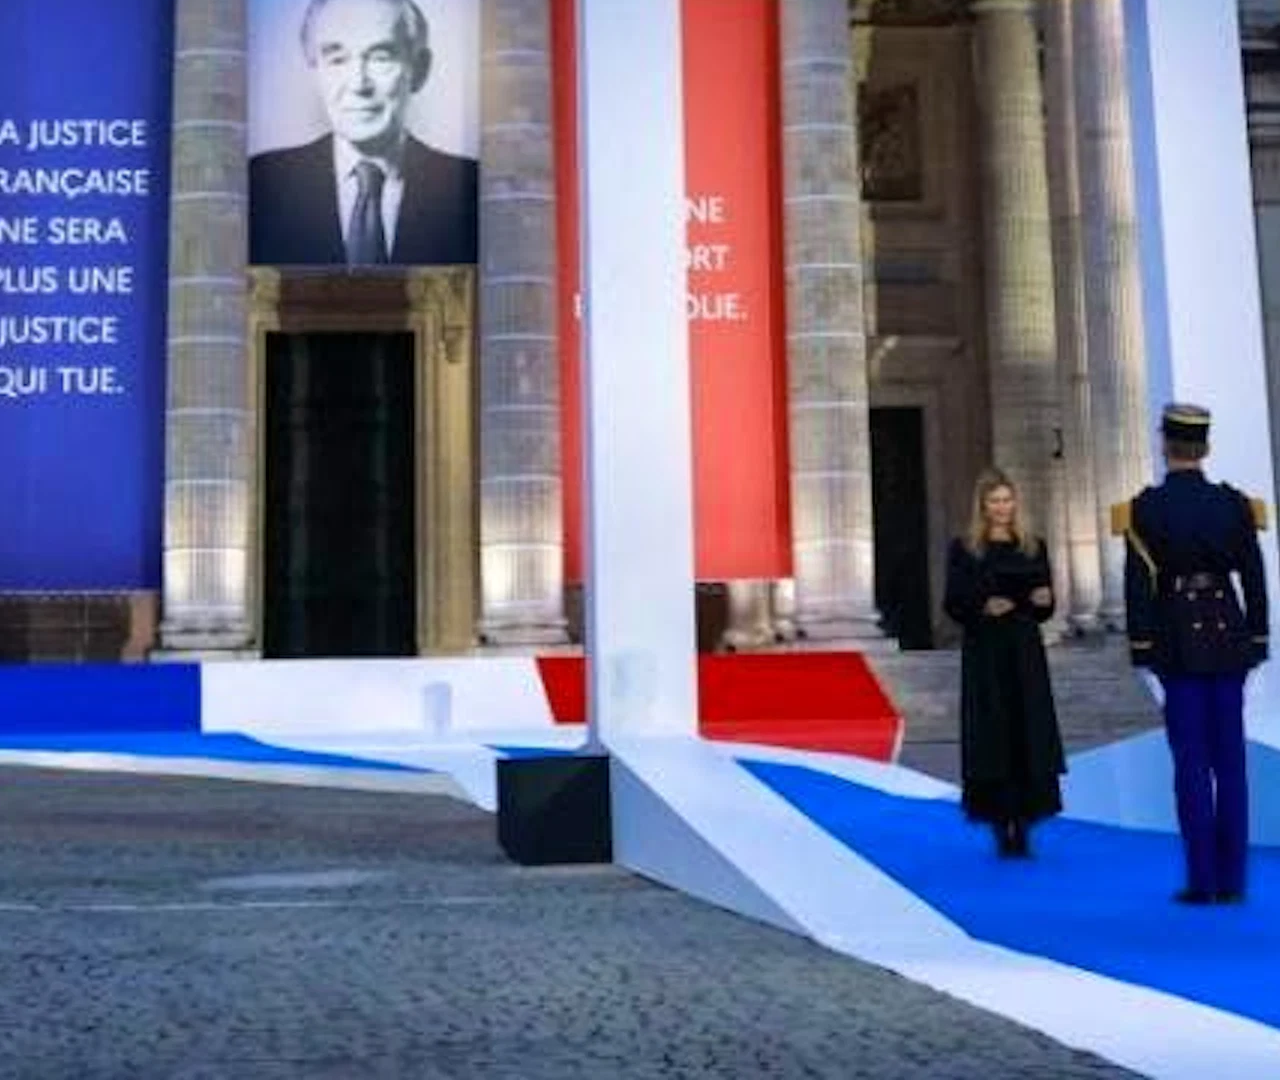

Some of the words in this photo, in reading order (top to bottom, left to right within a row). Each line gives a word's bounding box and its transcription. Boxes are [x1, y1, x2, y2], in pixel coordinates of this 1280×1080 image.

[26, 119, 148, 151] JUSTICE
[684, 196, 725, 223] NE
[47, 217, 127, 245] SERA
[67, 266, 134, 293] UNE
[56, 366, 124, 395] TUE.
